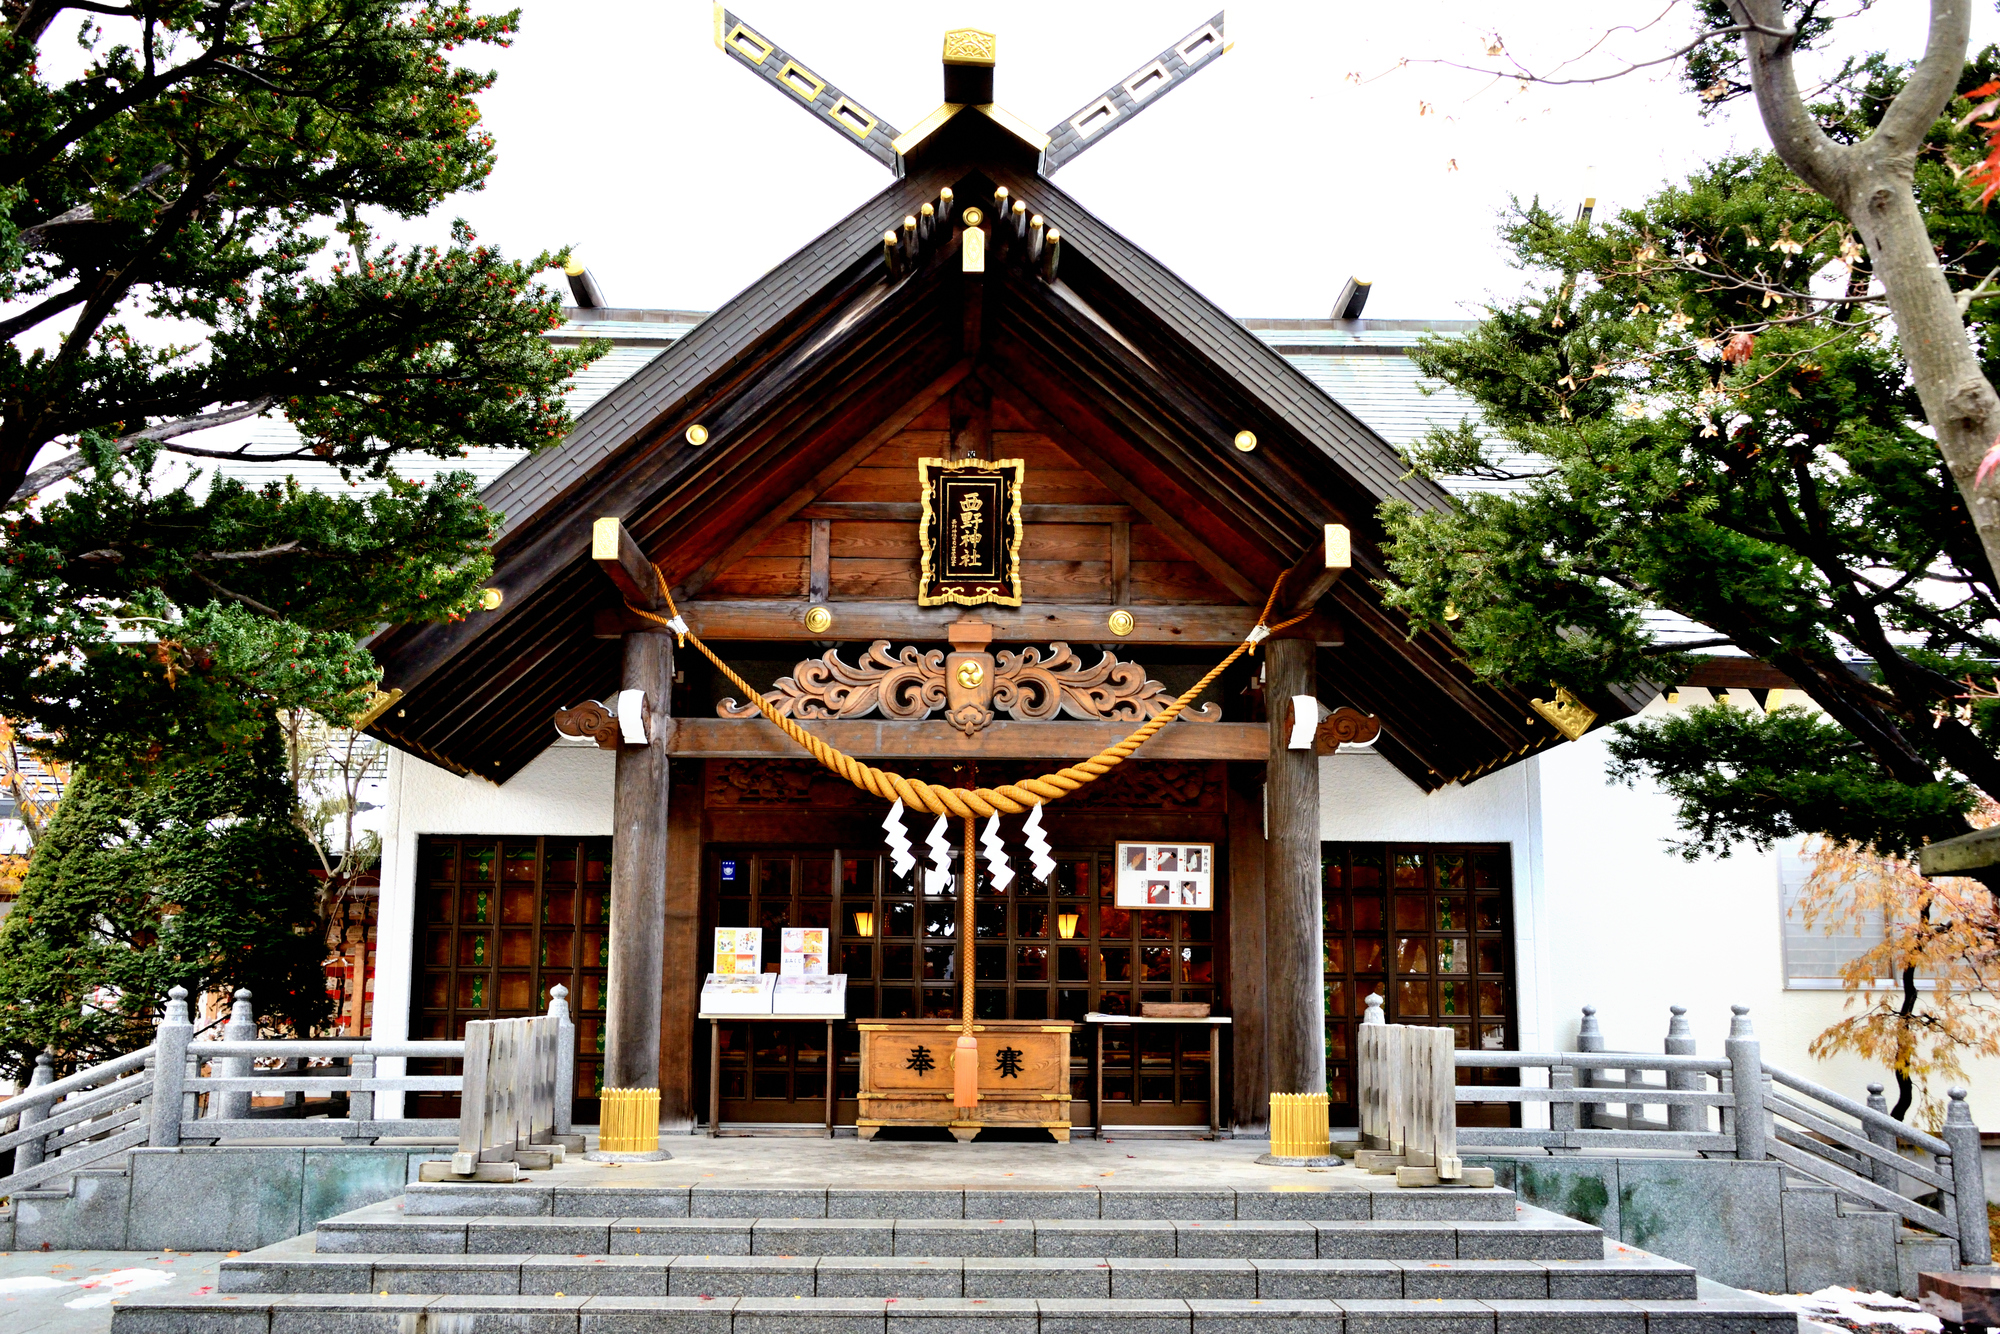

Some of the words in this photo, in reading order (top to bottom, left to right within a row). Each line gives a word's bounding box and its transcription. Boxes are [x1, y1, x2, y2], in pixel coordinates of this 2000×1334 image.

[959, 492, 983, 567] 西野神社
[906, 1045, 936, 1077] 奉
[995, 1046, 1025, 1079] 賽
